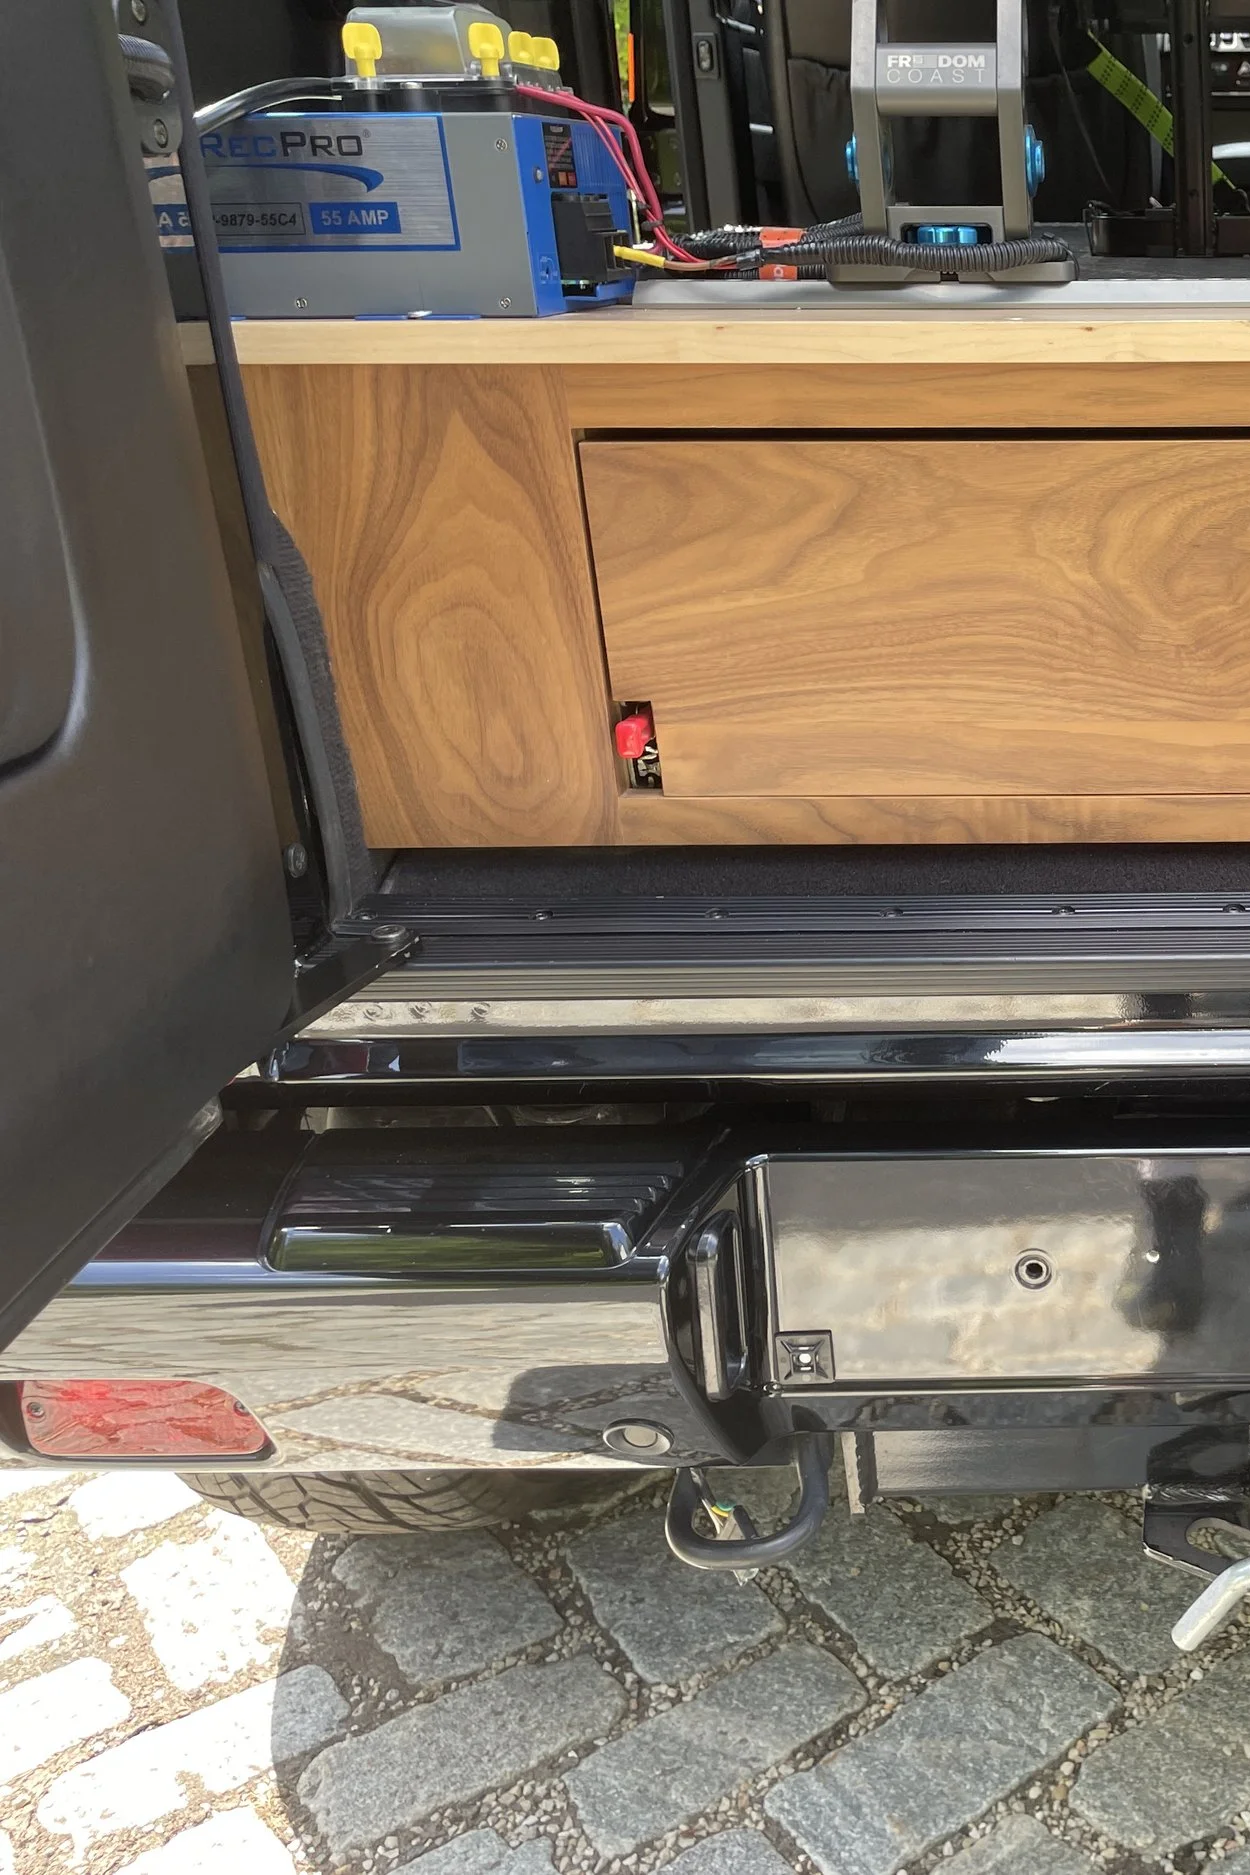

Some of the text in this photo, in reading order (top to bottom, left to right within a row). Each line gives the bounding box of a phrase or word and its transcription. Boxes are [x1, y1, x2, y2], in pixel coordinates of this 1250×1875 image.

[887, 69, 986, 84] COAST
[212, 213, 297, 227] -9879-55C4
[321, 210, 389, 226] 55 AMP
